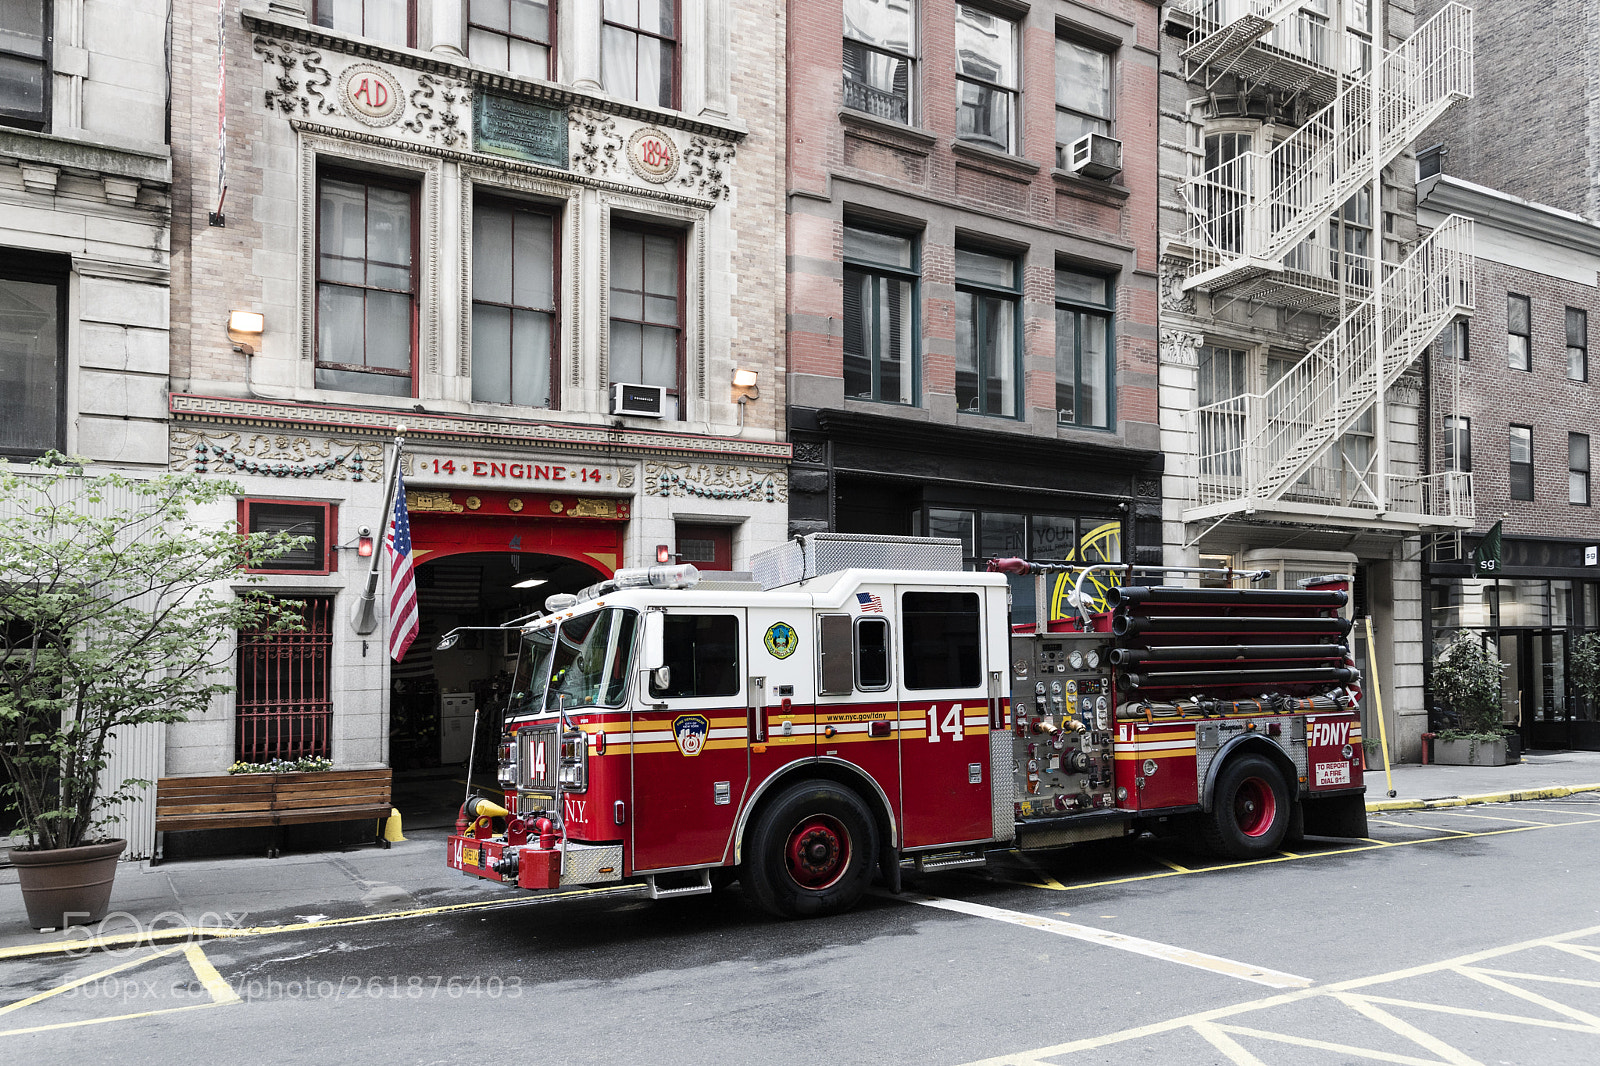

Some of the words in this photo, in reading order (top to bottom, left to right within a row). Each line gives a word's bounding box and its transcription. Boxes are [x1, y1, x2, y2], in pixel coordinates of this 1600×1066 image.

[354, 78, 388, 107] AD
[642, 140, 670, 167] 1894
[433, 459, 456, 474] 14
[473, 461, 566, 480] ENGINE
[581, 468, 602, 482] 14
[1005, 531, 1026, 550] FIN
[1480, 559, 1495, 570] sg
[1586, 552, 1596, 560] sg
[827, 712, 887, 721] www.nyc.gov/fdny
[927, 703, 964, 743] 14
[1312, 722, 1350, 747] FDNY
[530, 741, 546, 781] 14
[1326, 762, 1348, 770] REPORT
[565, 800, 589, 824] N.Y.
[454, 839, 462, 869] 14
